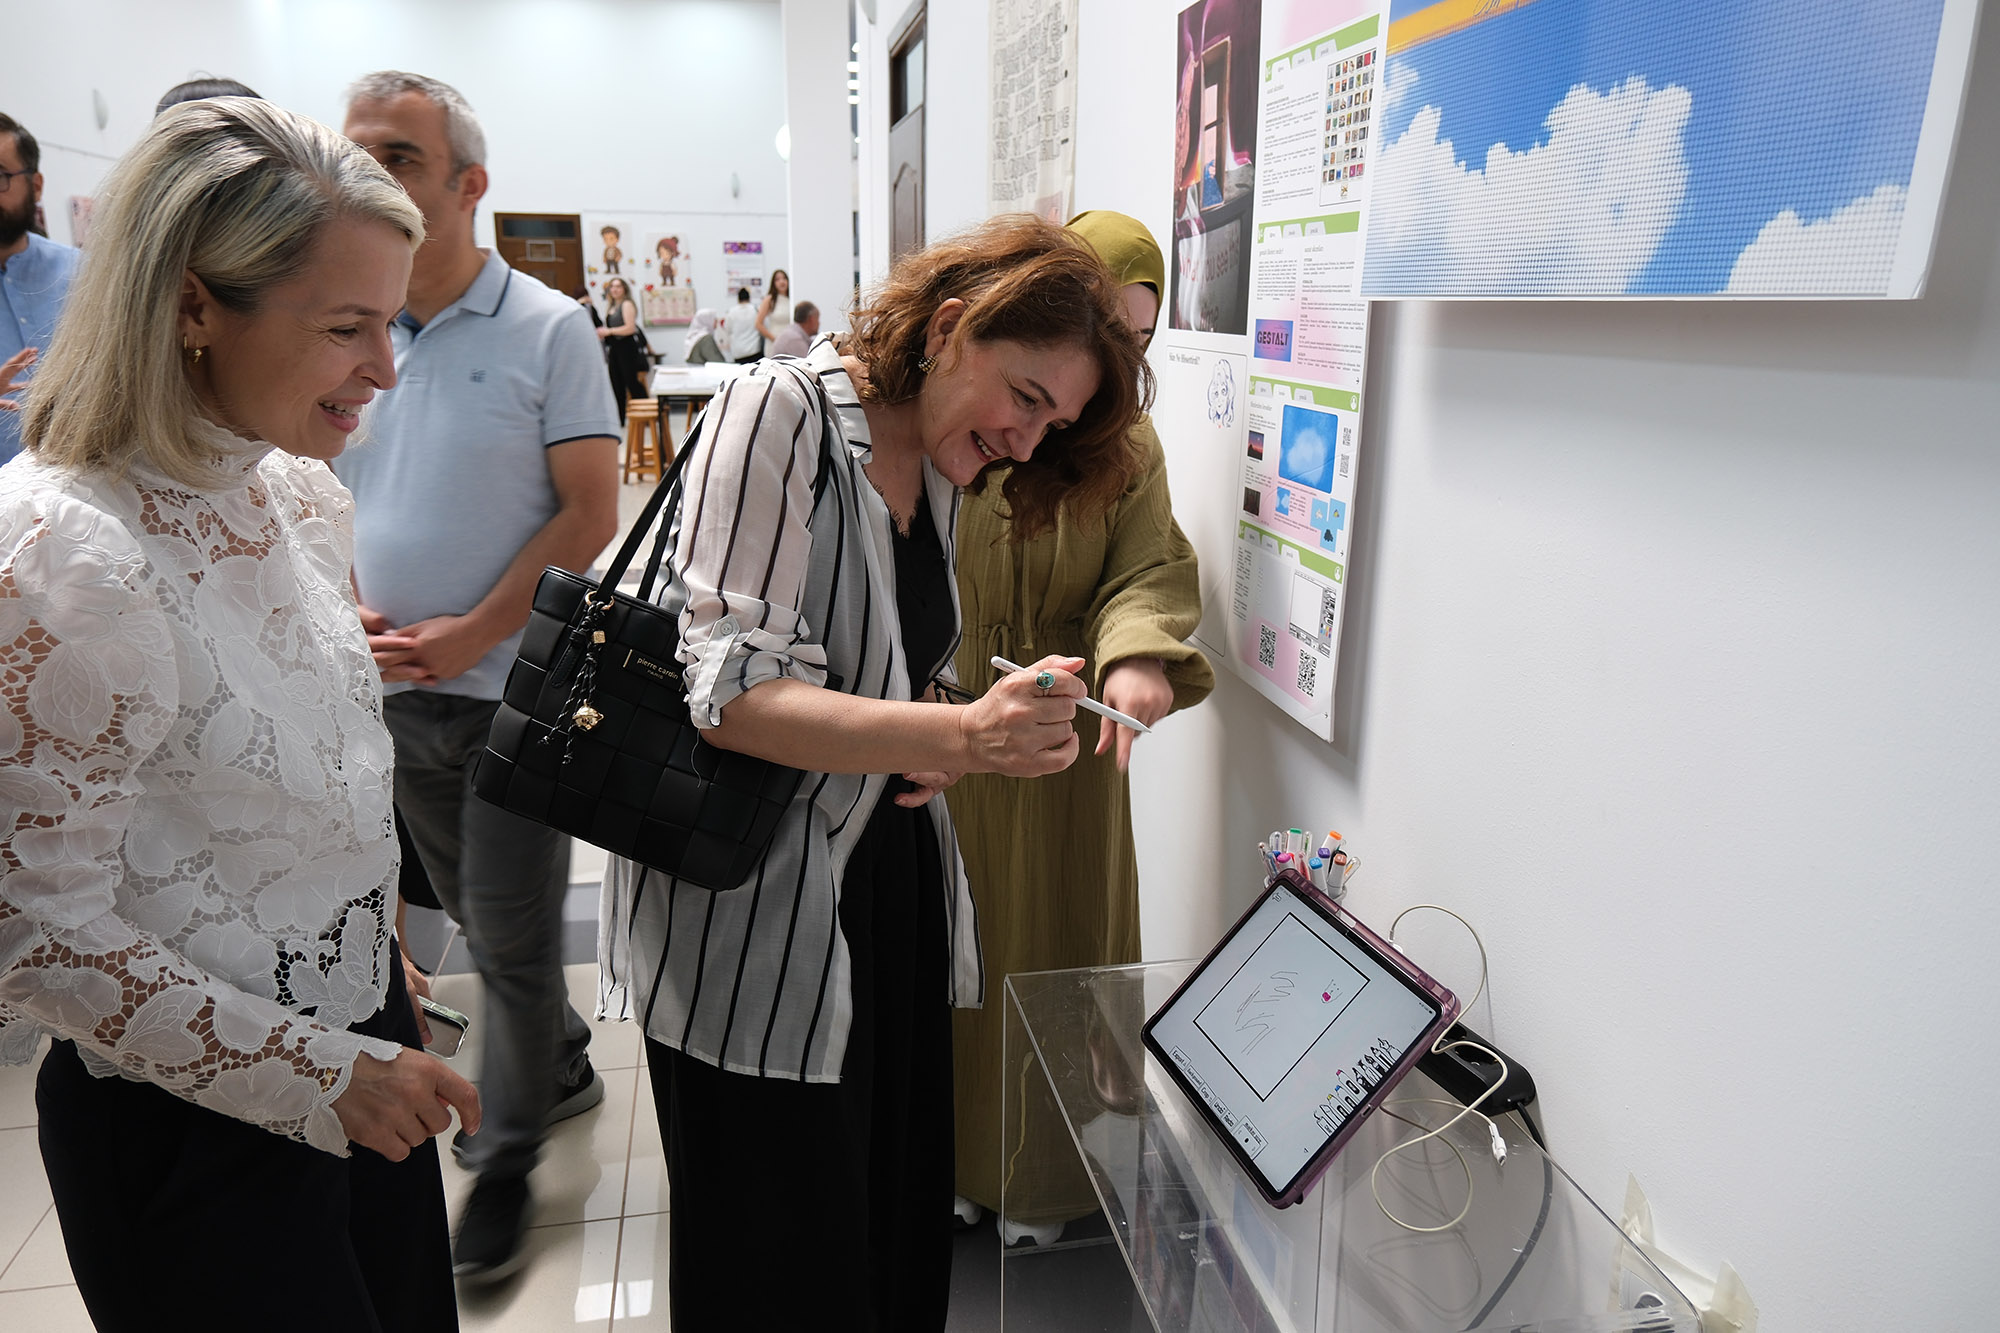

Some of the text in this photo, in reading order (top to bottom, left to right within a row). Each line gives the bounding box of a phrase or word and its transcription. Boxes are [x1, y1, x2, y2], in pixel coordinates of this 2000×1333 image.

[1257, 331, 1289, 346] GESTALT
[637, 657, 679, 680] pierre cardin
[1172, 1049, 1185, 1064] Export
[1201, 1086, 1210, 1099] Crop
[1213, 1102, 1225, 1115] Undo
